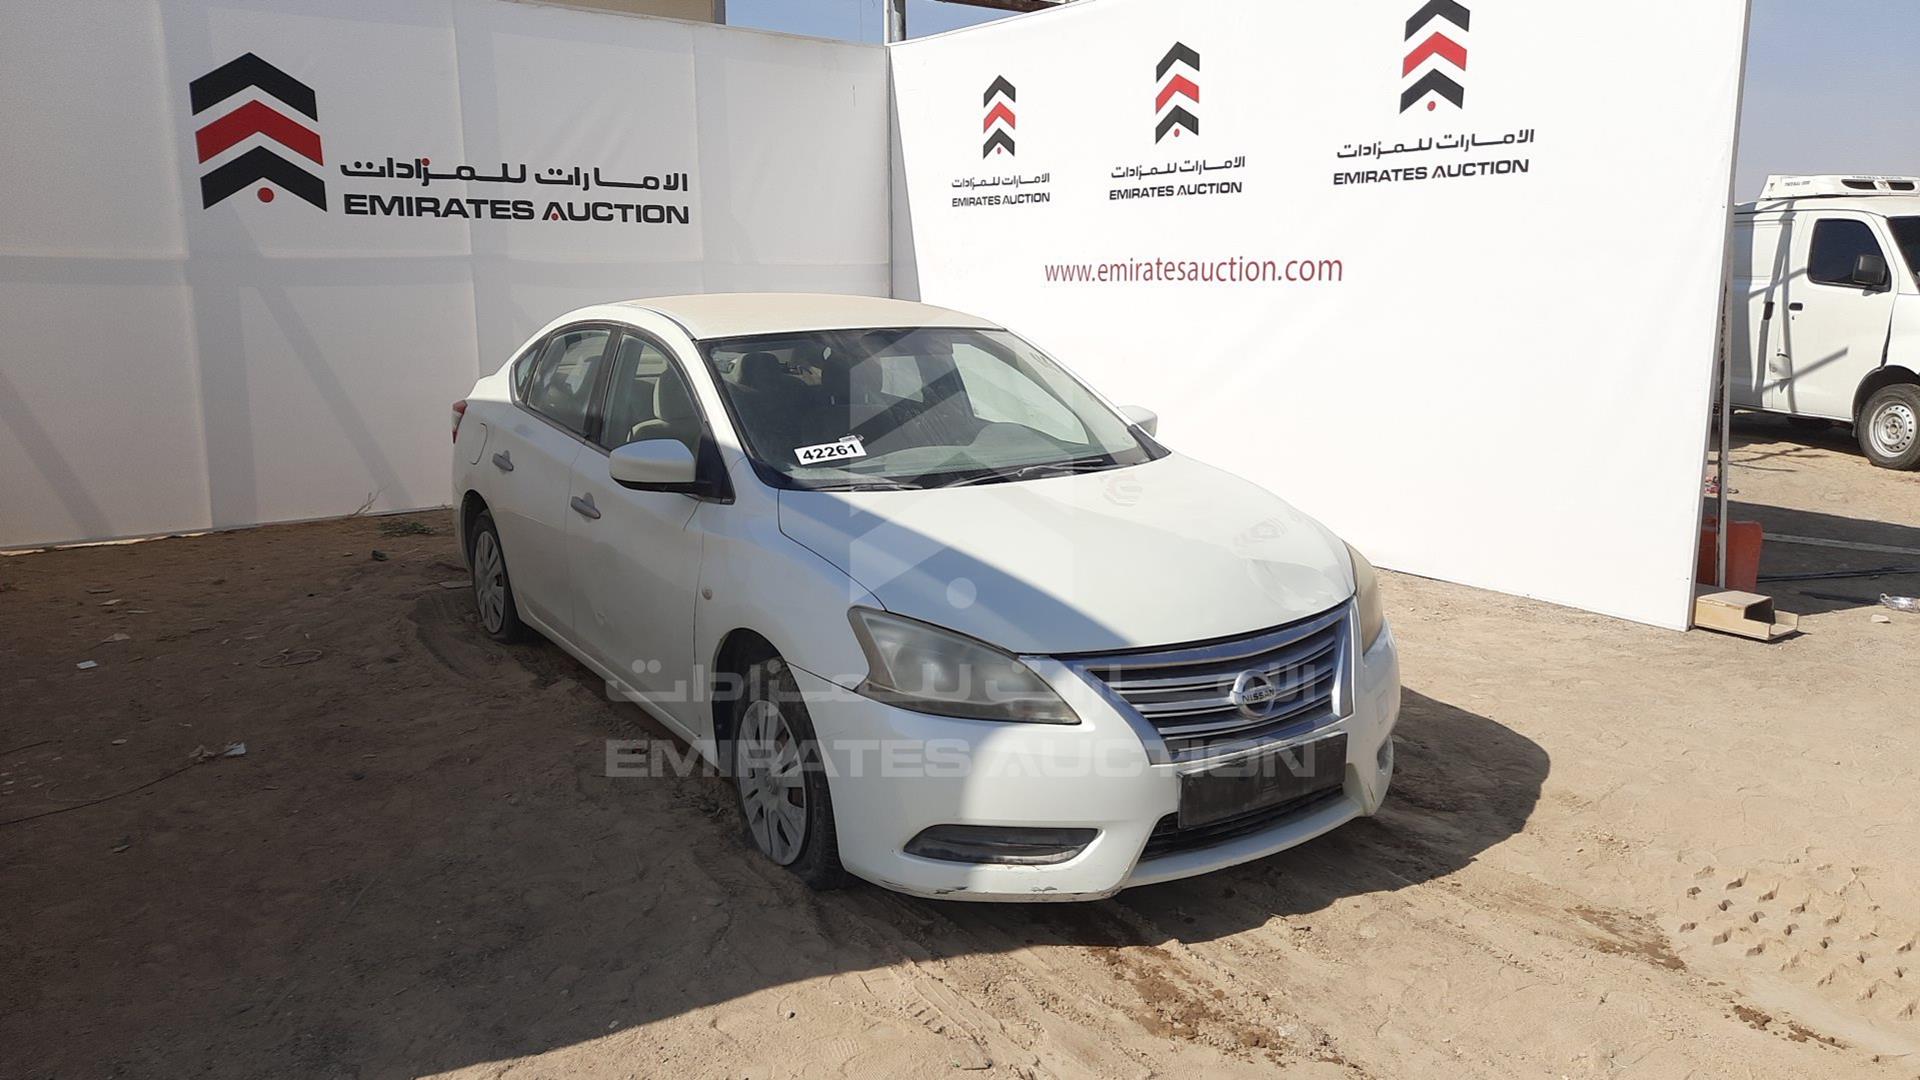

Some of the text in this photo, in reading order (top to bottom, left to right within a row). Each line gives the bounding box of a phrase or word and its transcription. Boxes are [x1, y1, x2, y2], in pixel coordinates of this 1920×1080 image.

[1333, 159, 1529, 185] EMIRATES AUCTION
[952, 191, 1050, 207] EMIRATES AUCTION
[1109, 181, 1242, 201] EMIRATES AUCTION
[343, 193, 690, 225] EMIRATES AUCTION
[1044, 256, 1343, 282] www.emiratesauction.com
[803, 443, 858, 460] 42261
[1241, 688, 1276, 702] NISSAN
